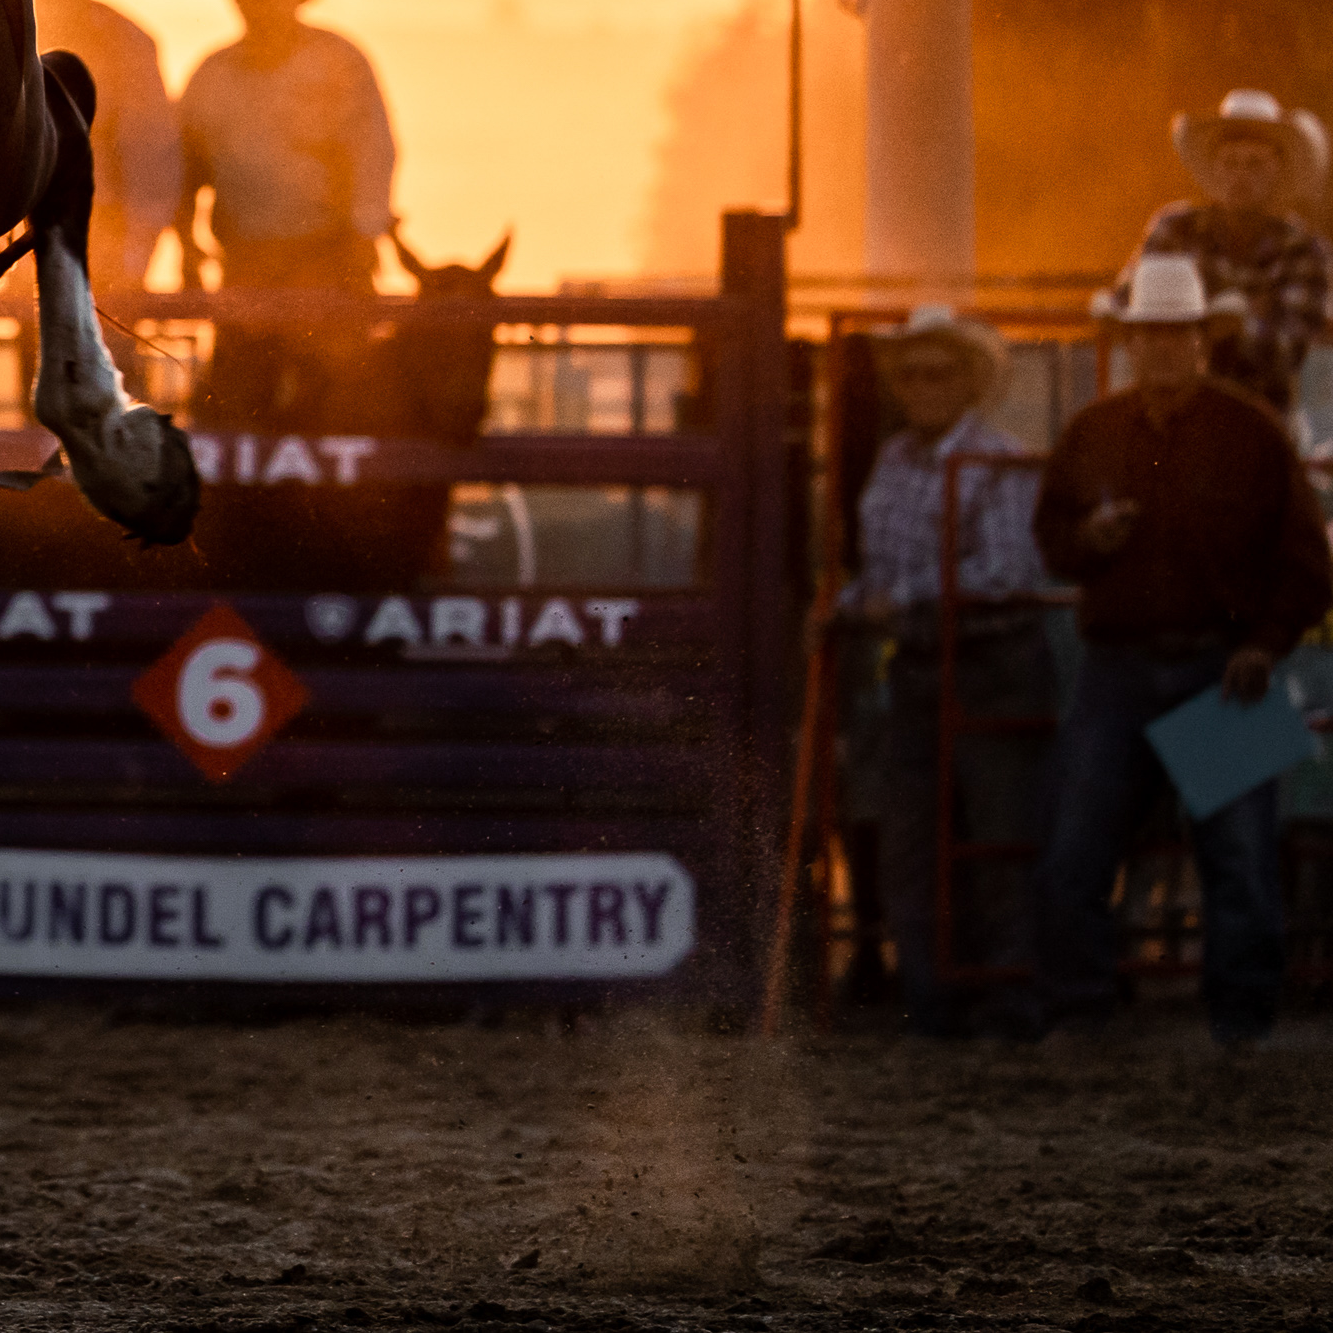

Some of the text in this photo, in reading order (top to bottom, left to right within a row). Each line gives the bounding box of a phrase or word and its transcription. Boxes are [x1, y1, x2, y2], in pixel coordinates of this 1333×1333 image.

[190, 434, 379, 486] RIAT
[363, 594, 639, 647] ARIAT
[174, 635, 269, 750] 6
[251, 880, 671, 952] CARPENTRY
